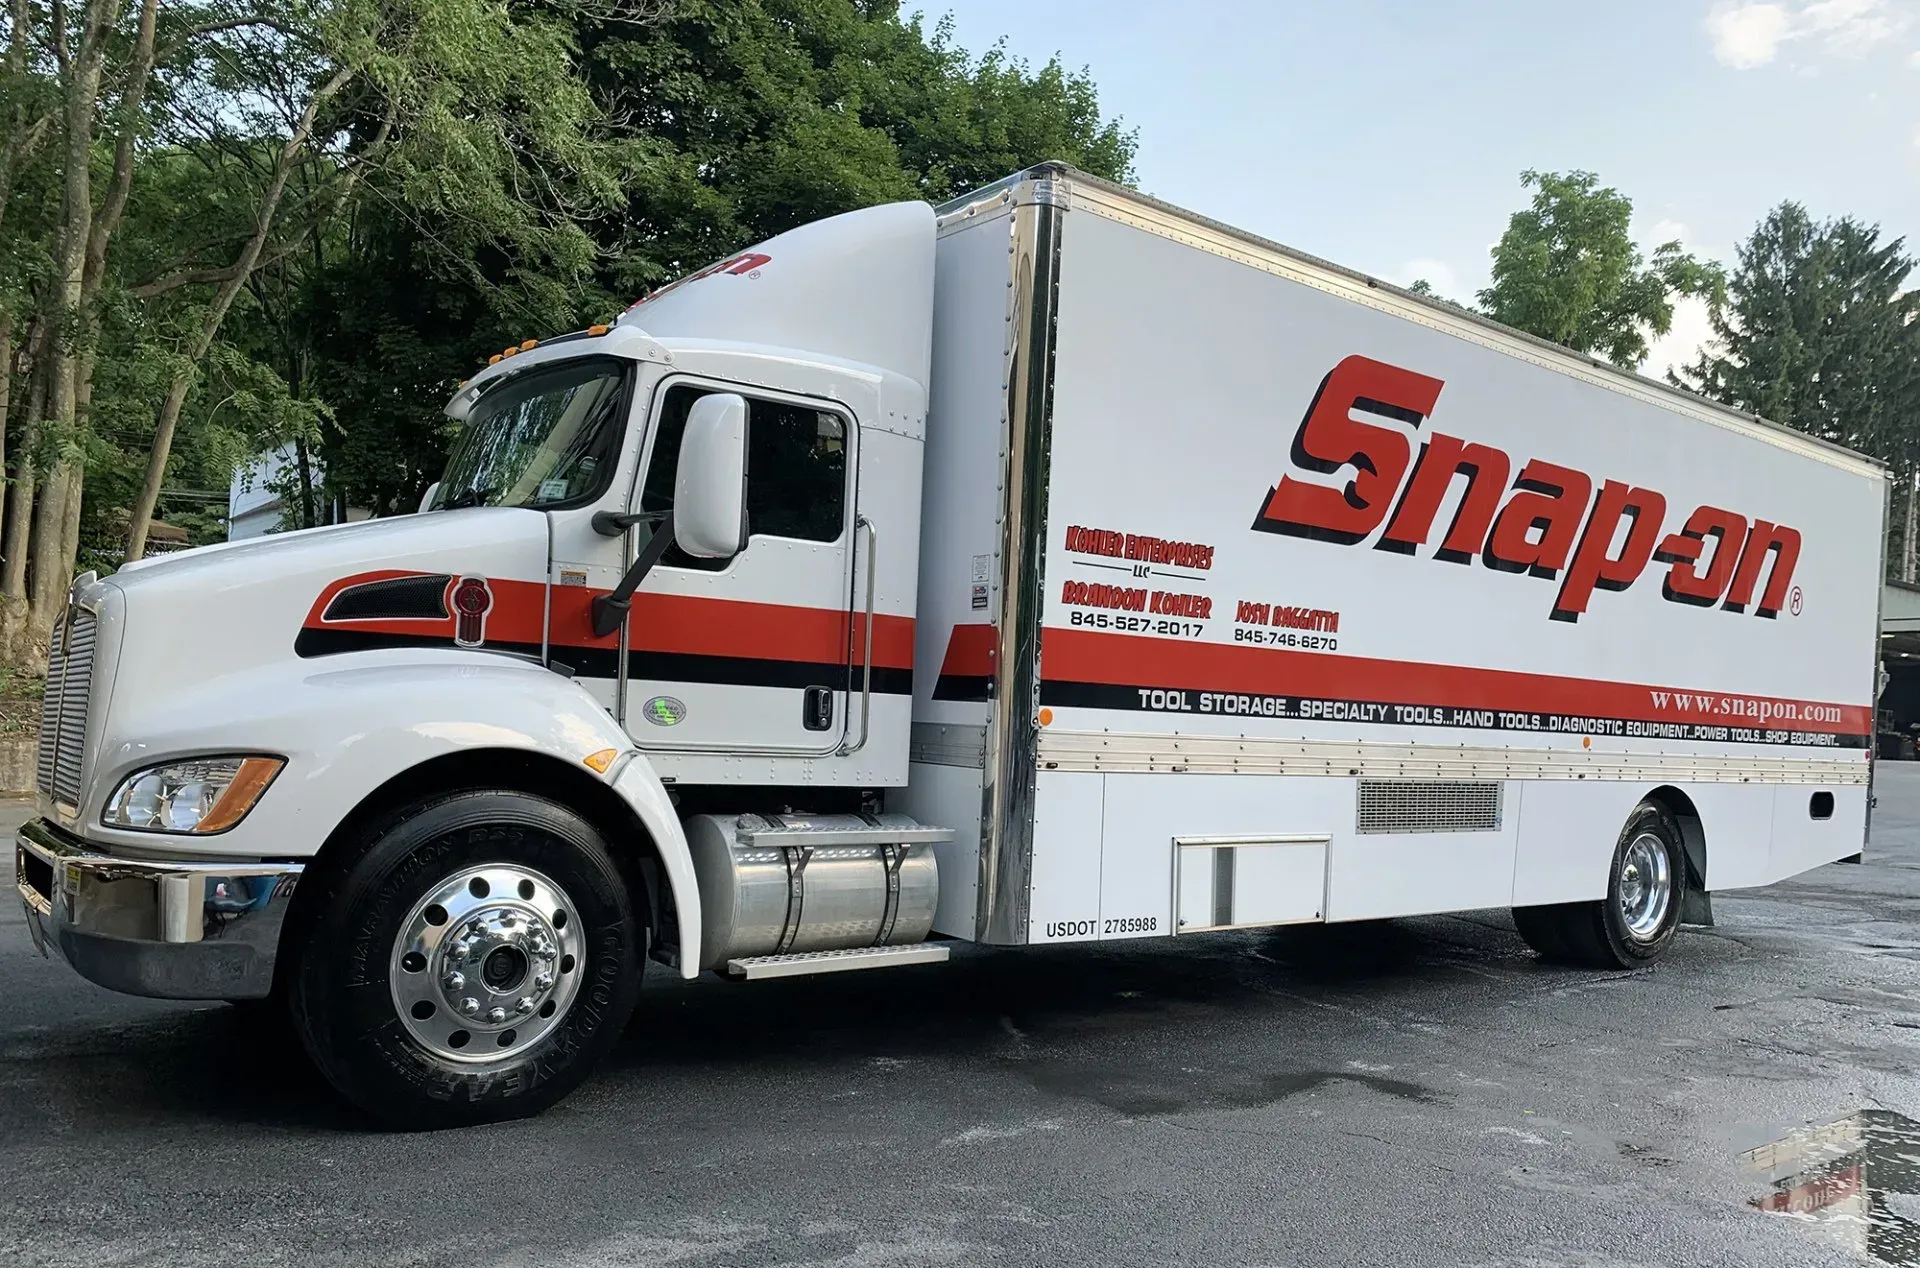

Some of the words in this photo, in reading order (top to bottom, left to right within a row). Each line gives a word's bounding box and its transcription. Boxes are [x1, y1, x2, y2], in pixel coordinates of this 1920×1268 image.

[1251, 355, 1802, 623] Snap-on
[1064, 525, 1124, 558] KOHLER
[1124, 534, 1214, 570] ENTERPRISES
[1133, 565, 1150, 578] LLC
[1062, 580, 1147, 612] BRANDON
[1149, 591, 1212, 619] KOHLER
[1070, 611, 1204, 637] 845-527-2017
[1235, 600, 1270, 625] JOSH
[1234, 628, 1338, 651] 845-746-6270
[1138, 689, 1192, 711] TOOL
[1650, 691, 1842, 723] www.snapon.com
[1046, 921, 1097, 938] USDOT
[1104, 917, 1158, 934] 2785988
